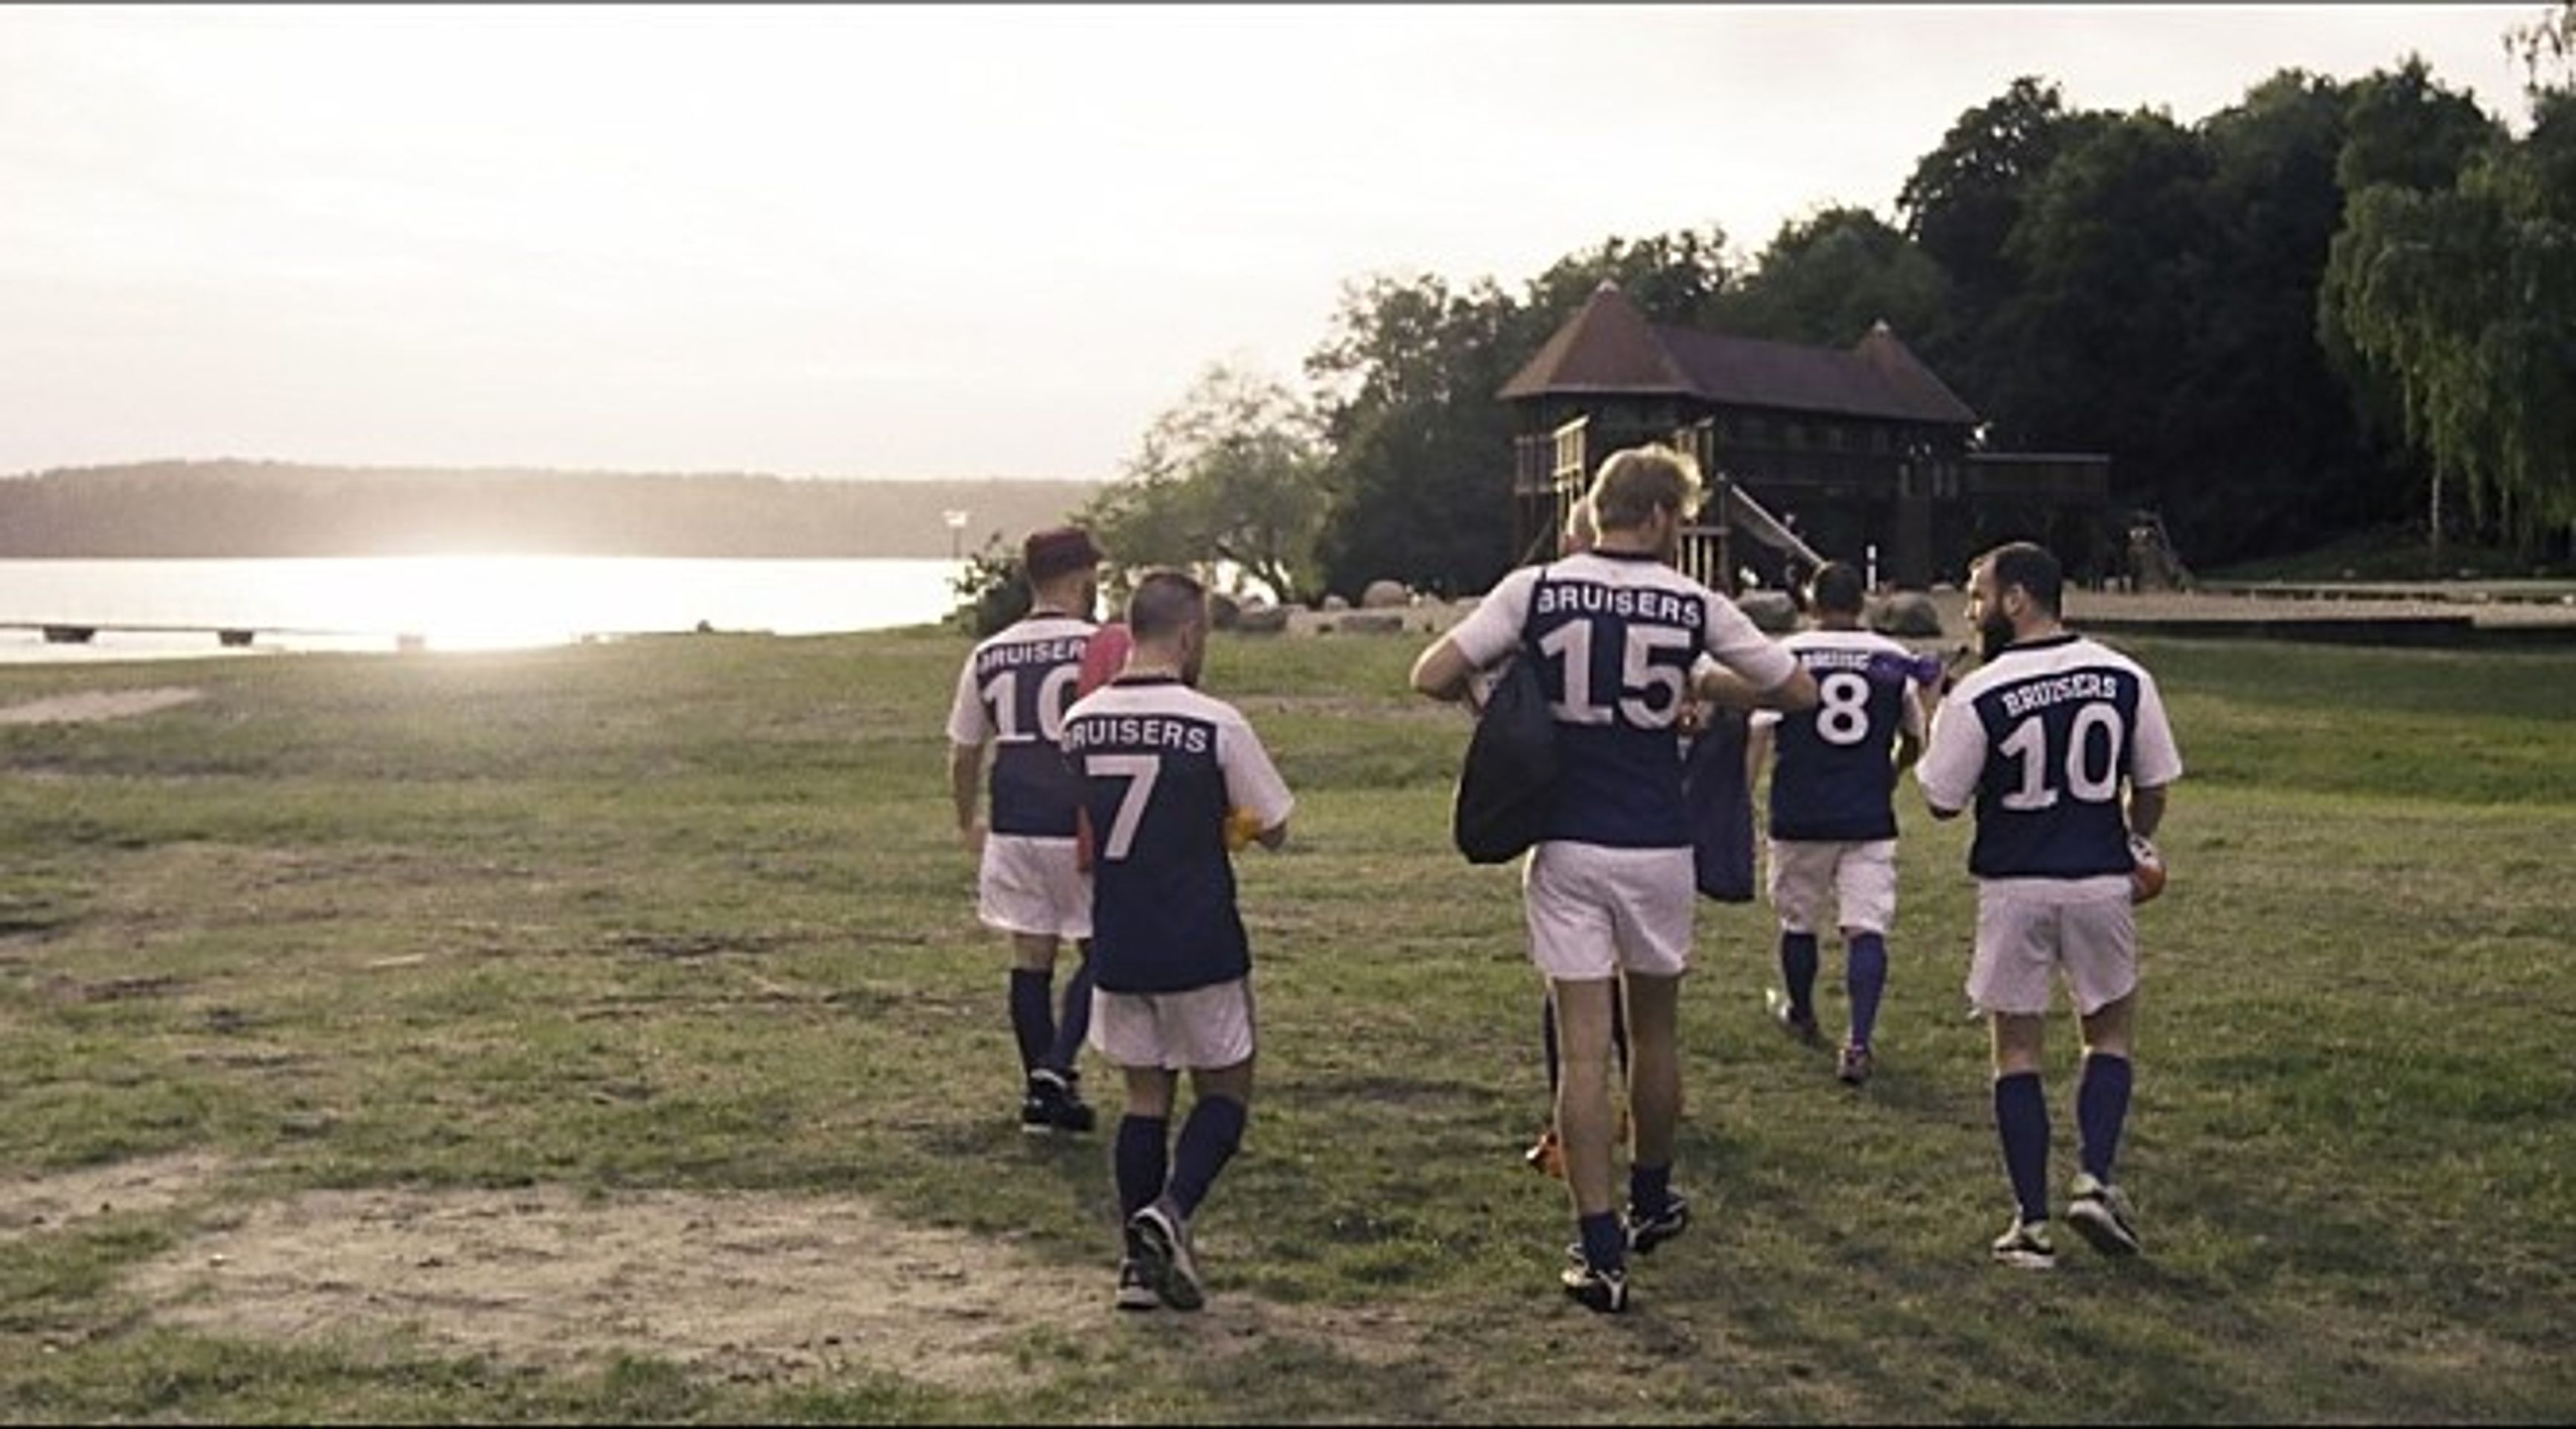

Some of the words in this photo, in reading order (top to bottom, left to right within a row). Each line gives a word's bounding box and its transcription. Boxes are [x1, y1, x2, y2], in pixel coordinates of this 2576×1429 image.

[1537, 584, 1702, 626] BRUISERS
[978, 639, 1086, 674] RUISER
[1538, 618, 1691, 729] 15
[1816, 672, 1869, 744] 8
[2002, 674, 2117, 717] BRUISERS
[1998, 703, 2123, 811] 10
[1085, 754, 1161, 860] 7
